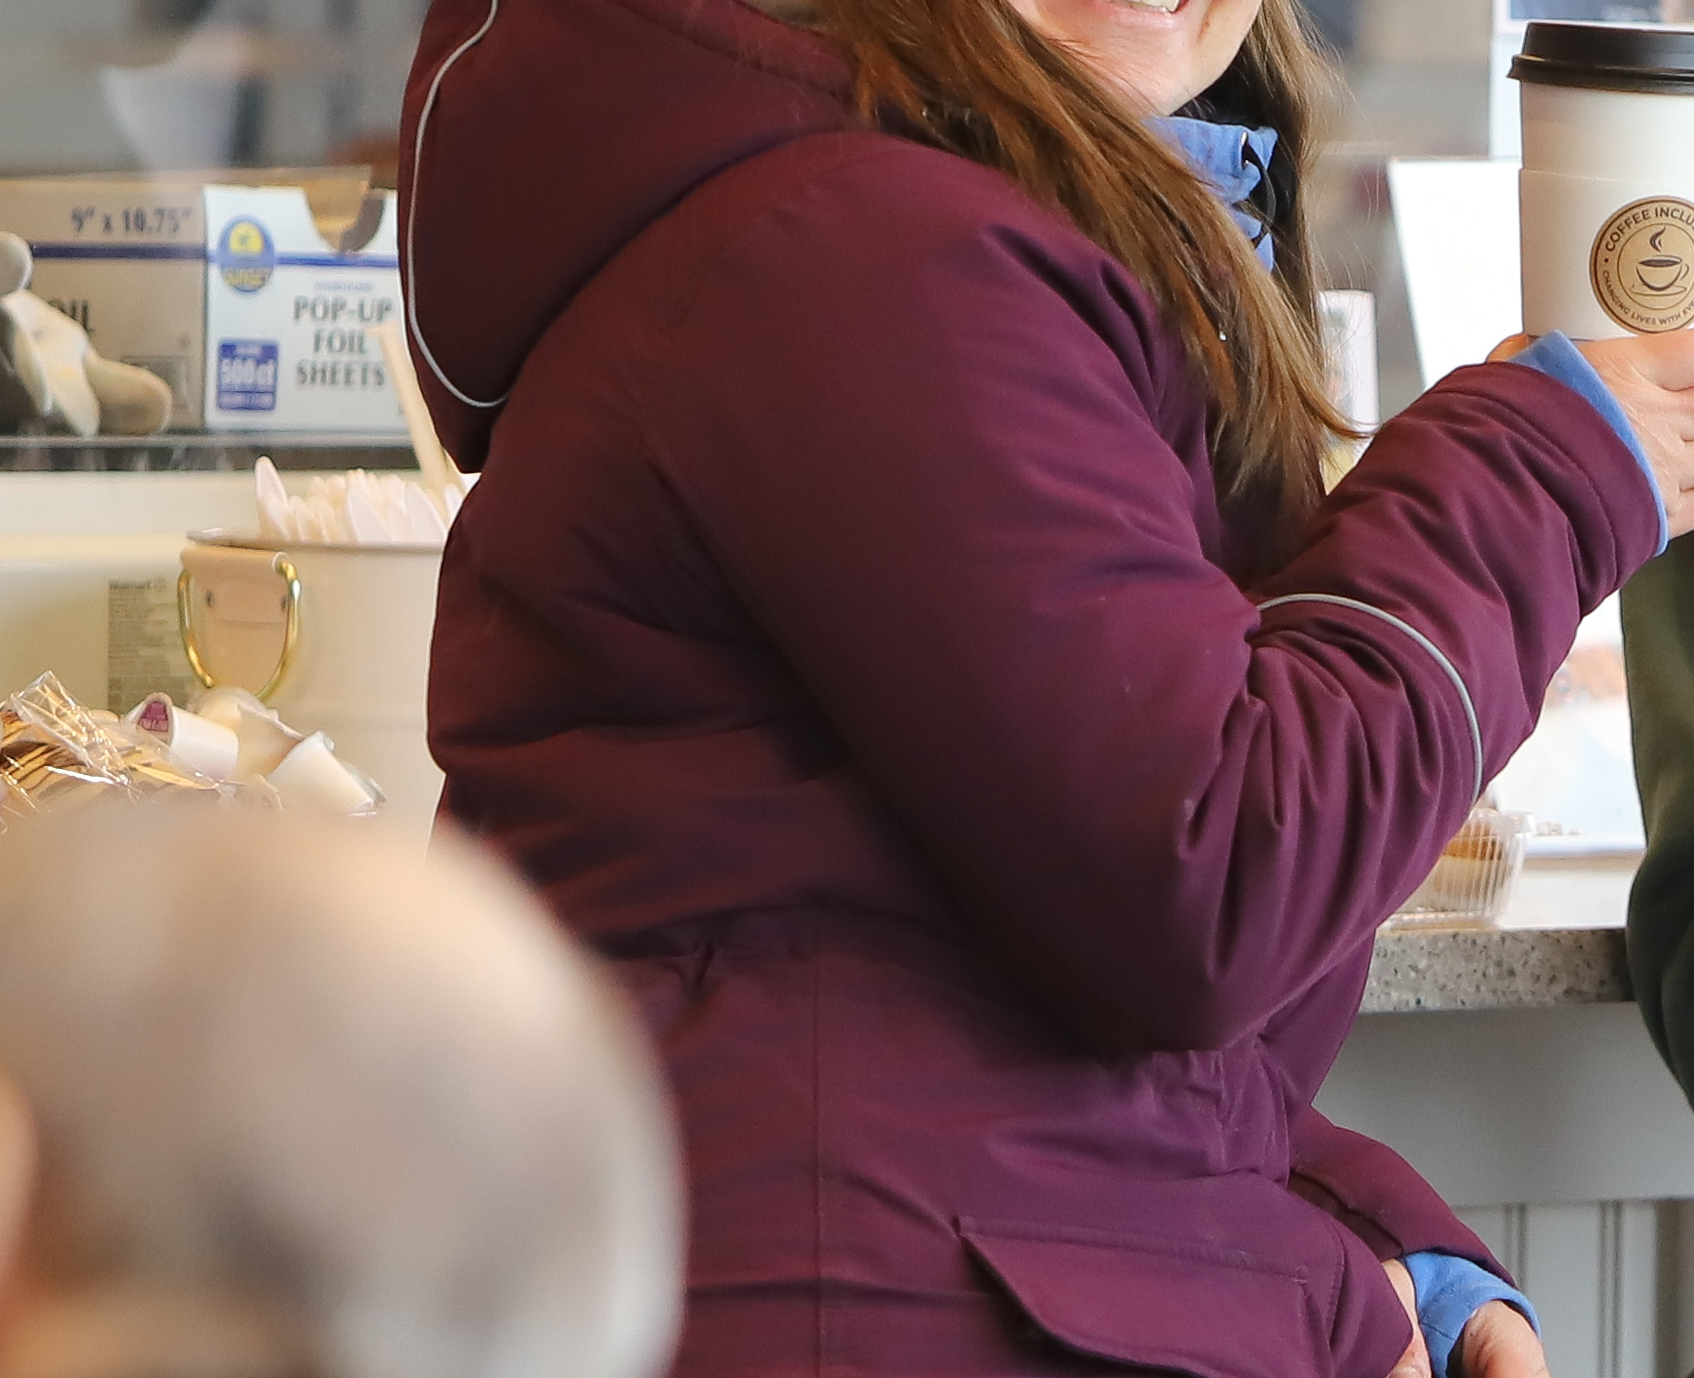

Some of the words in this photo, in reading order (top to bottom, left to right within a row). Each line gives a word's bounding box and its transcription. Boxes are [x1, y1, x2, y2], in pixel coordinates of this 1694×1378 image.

[1605, 208, 1652, 253] COFFEE
[293, 295, 393, 322] POP-UP
[1602, 270, 1629, 315] CHANGING
[1631, 312, 1656, 325] LIVES
[1658, 311, 1682, 325] WITH
[313, 328, 367, 354] FOIL
[296, 360, 386, 387] SHEETS
